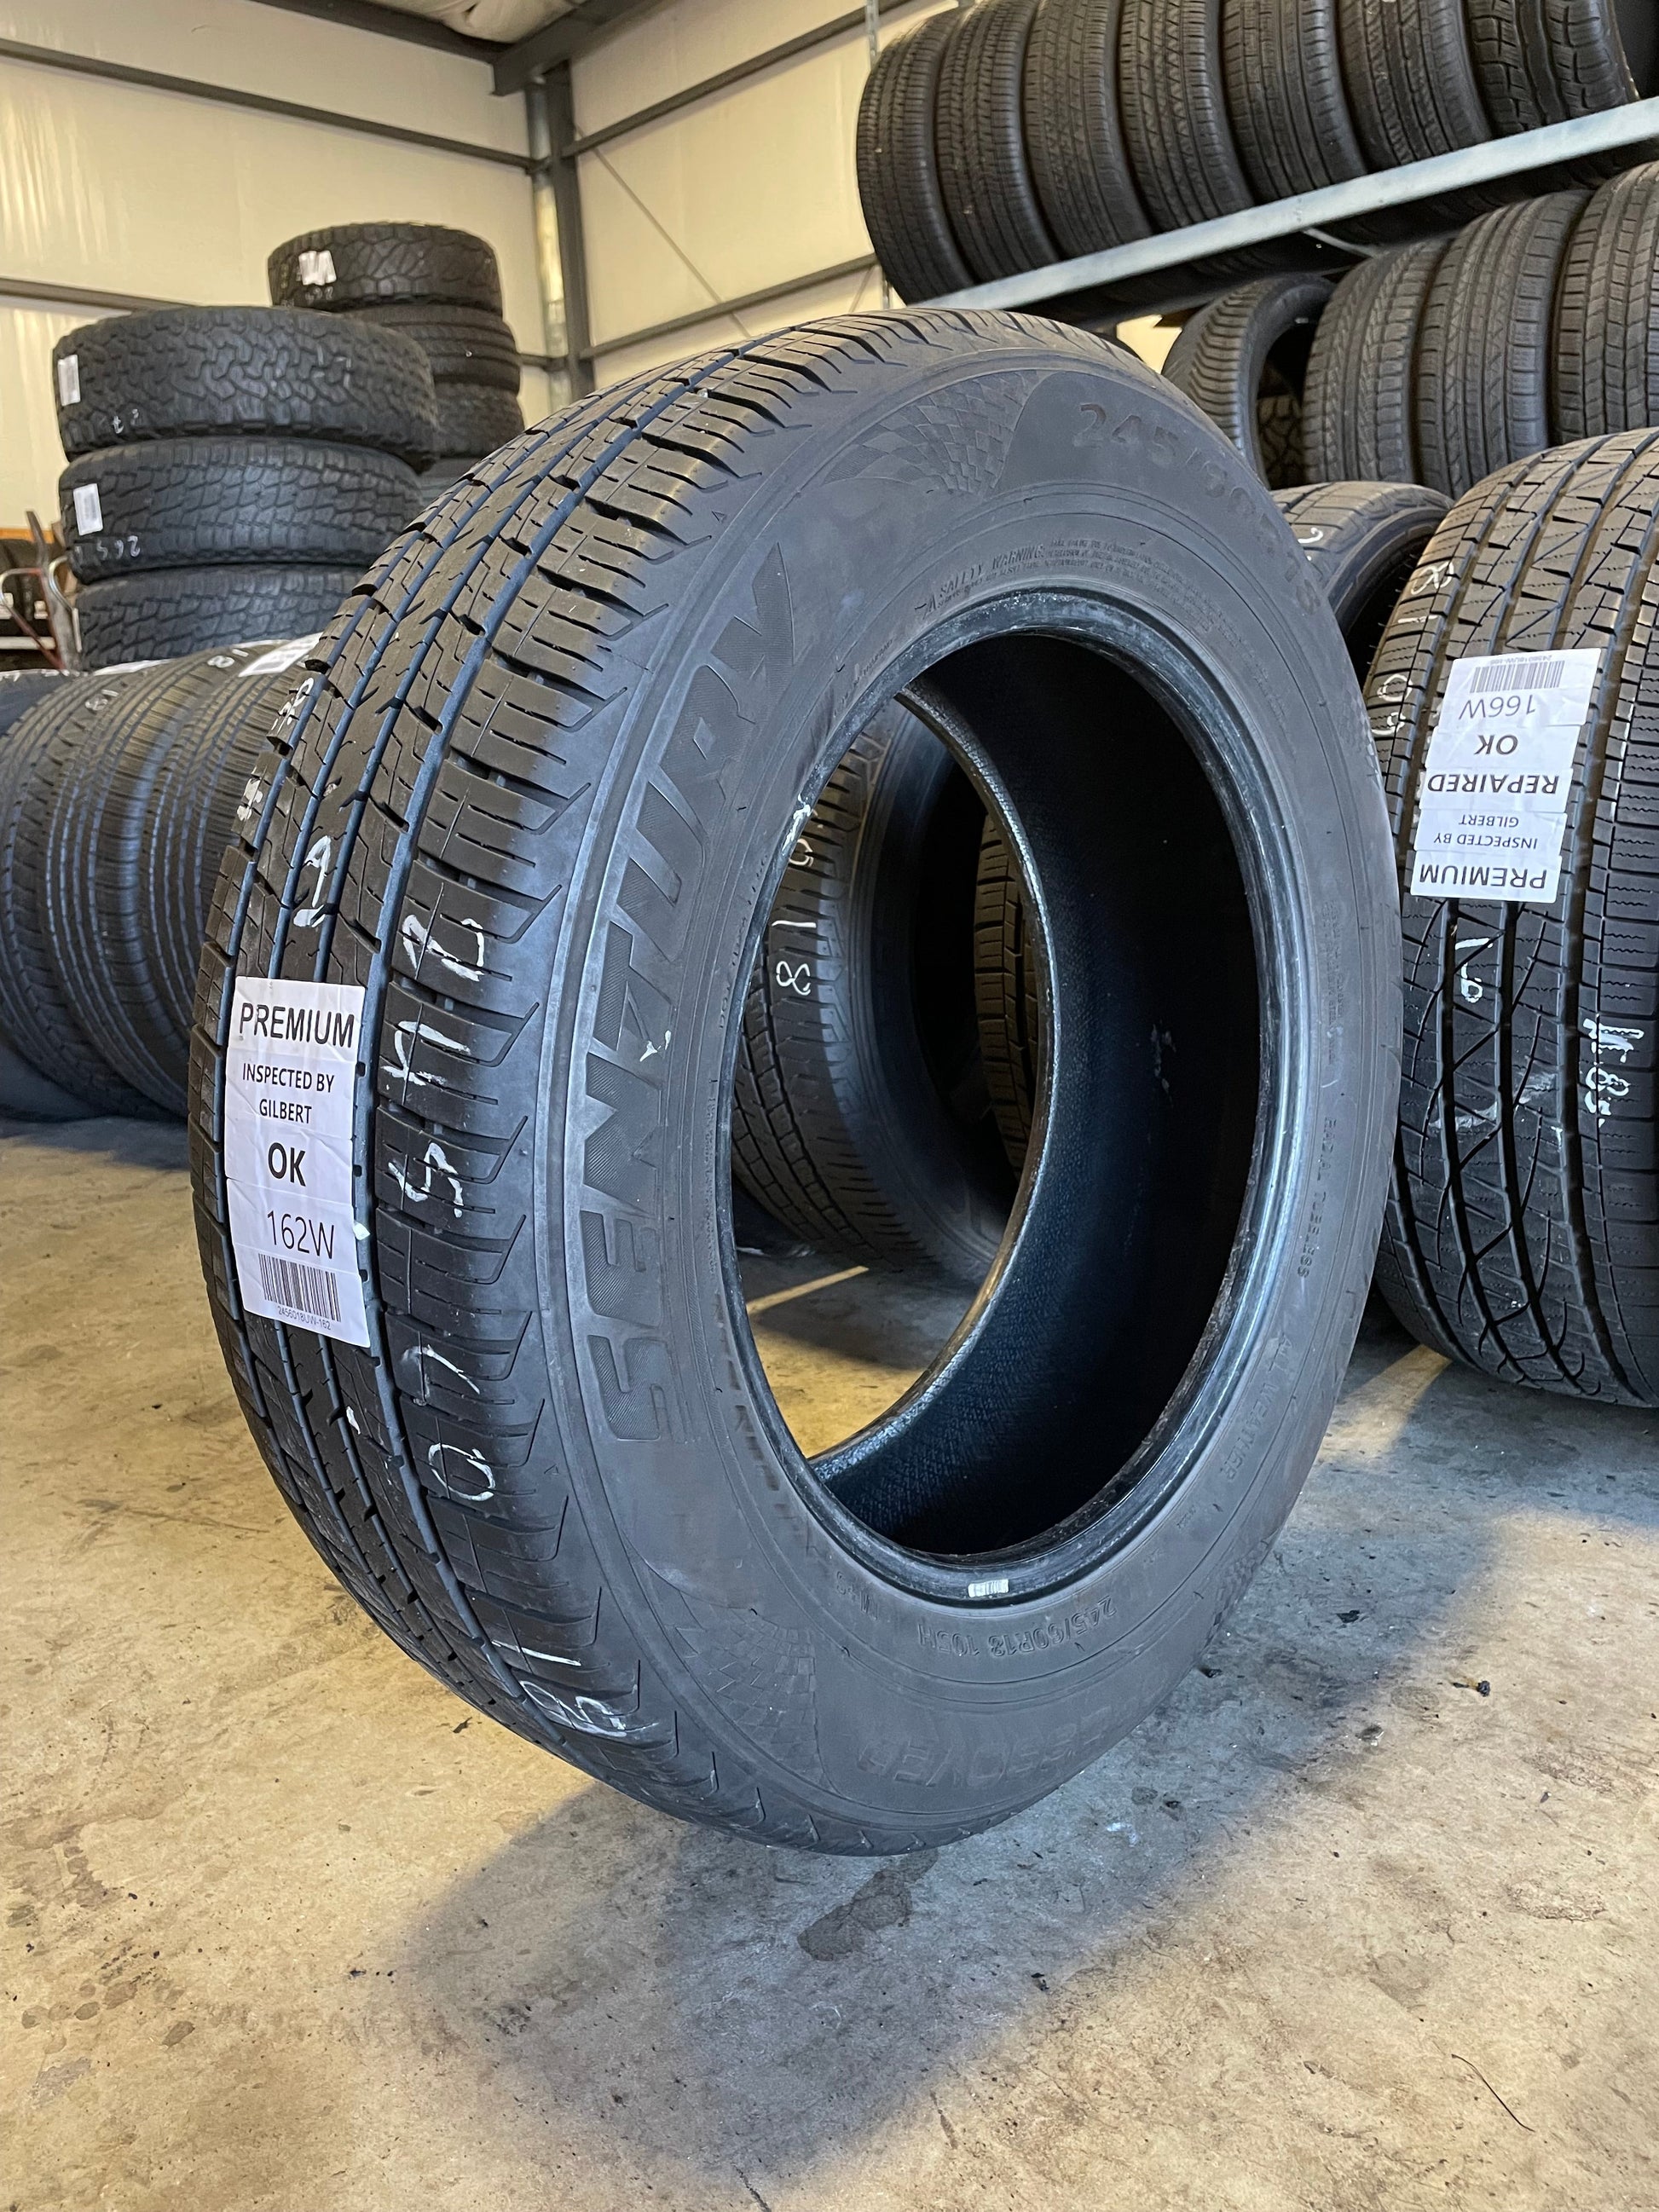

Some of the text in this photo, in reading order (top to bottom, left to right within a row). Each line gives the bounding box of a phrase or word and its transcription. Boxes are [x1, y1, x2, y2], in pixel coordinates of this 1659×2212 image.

[1459, 694, 1536, 720] 166W
[1473, 734, 1518, 756] OK
[1427, 773, 1559, 794] REPAIRED
[1458, 814, 1520, 828] GILBERT
[1433, 832, 1538, 850] INSPECTED BY
[1419, 863, 1547, 889] PREMIUM
[580, 539, 795, 1446] SENTURY
[239, 1002, 355, 1048] PREMIUM
[242, 1063, 335, 1094] INSPECTED BY
[259, 1099, 312, 1124] GILBERT
[268, 1142, 306, 1187] OK
[267, 1210, 335, 1260] 162W
[1218, 1381, 1281, 1481] WEATHER
[918, 1596, 1117, 1657] 245/60R18 105H
